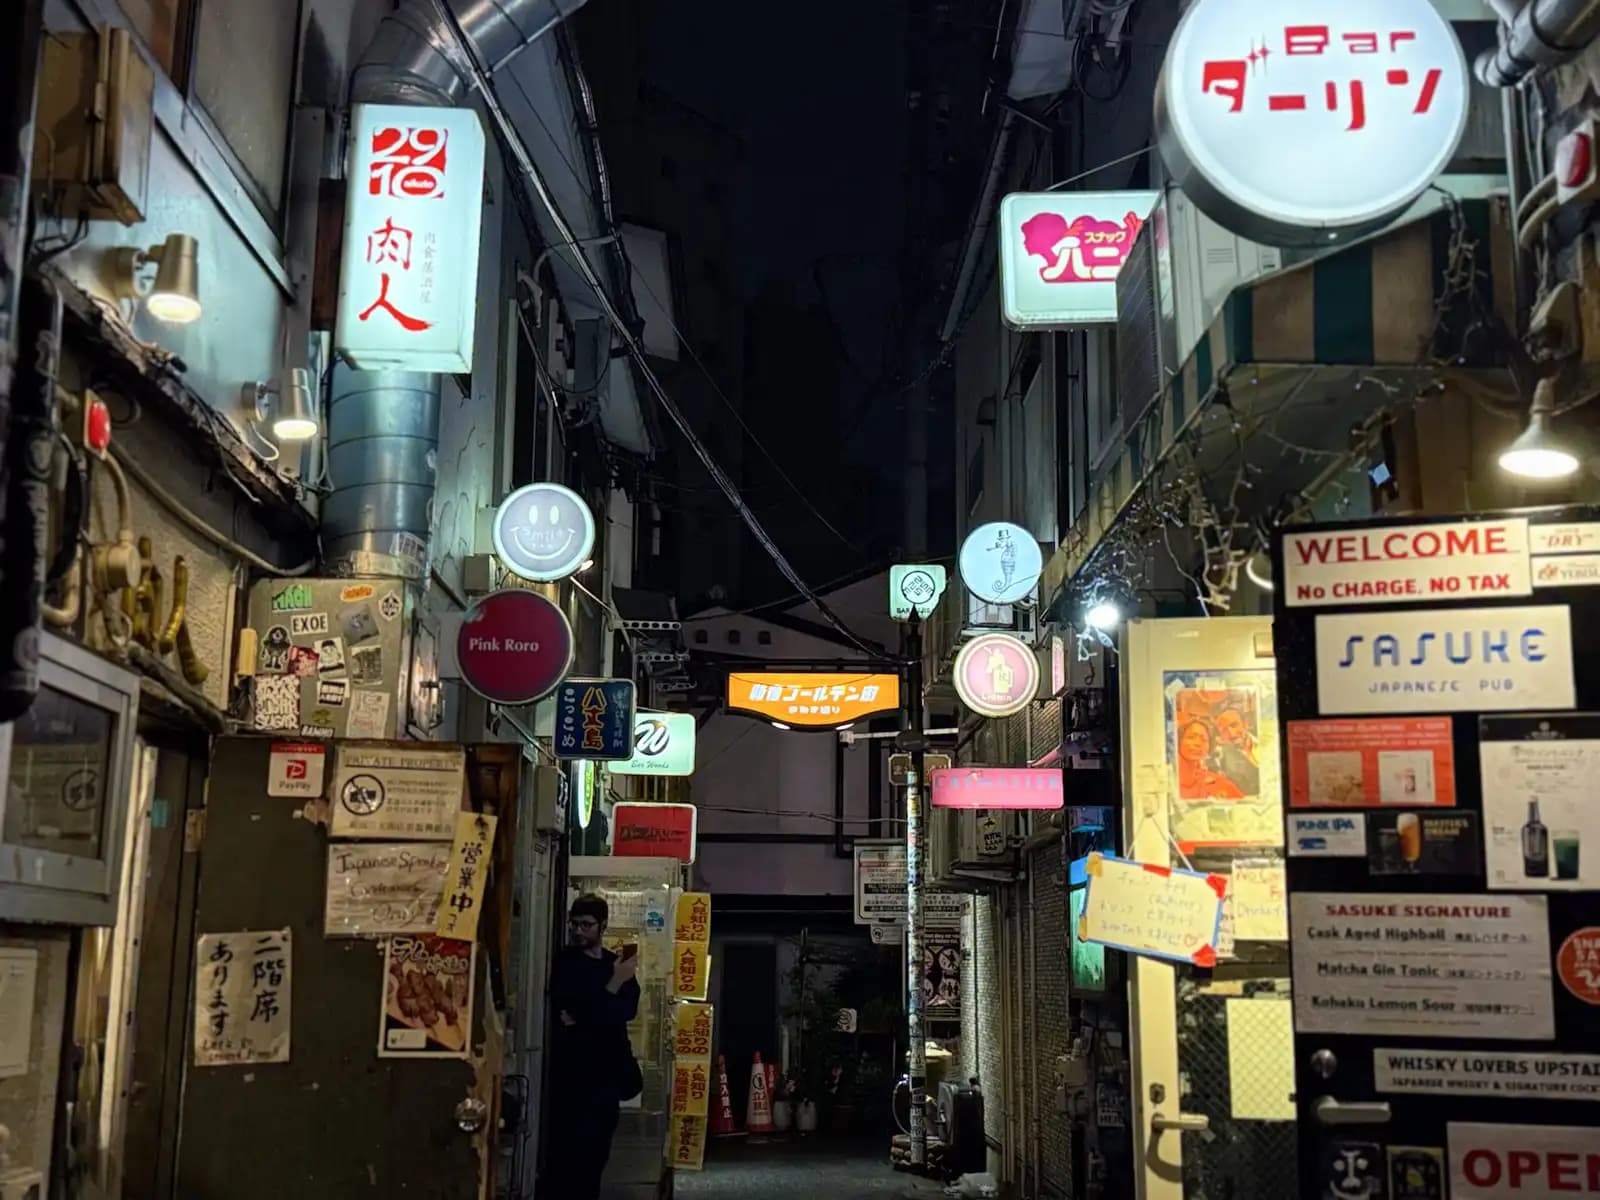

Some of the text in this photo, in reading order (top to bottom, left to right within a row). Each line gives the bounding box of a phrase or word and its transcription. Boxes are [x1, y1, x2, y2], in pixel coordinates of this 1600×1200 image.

[1284, 25, 1415, 56] Bar
[1084, 231, 1126, 244] スナック
[1042, 236, 1128, 280] ハニ
[359, 217, 434, 331] 肉人
[1294, 527, 1508, 566] WELCOME
[1429, 575, 1461, 593] NO
[1466, 574, 1511, 591] TAX
[292, 615, 328, 633] EXOE
[469, 637, 540, 652] Pink Roro
[1339, 628, 1548, 668] SASUKE
[1368, 678, 1515, 695] JAPANESE PUB
[1326, 904, 1511, 918] SASUKE SIGNATURE
[1307, 926, 1340, 940] Cask
[1344, 928, 1381, 942] Aged
[1385, 926, 1446, 942] Highball
[1317, 962, 1368, 977] Matcha
[1373, 964, 1396, 977] Gin
[1400, 965, 1440, 978] Tonic
[251, 936, 286, 1023] 二階席
[208, 941, 234, 1037] あります
[1369, 997, 1418, 1011] Lemon
[1422, 999, 1455, 1012] Sour
[1388, 1056, 1458, 1072] WHISKY
[1463, 1058, 1528, 1075] LOVERS
[1447, 1079, 1489, 1089] WHISKY
